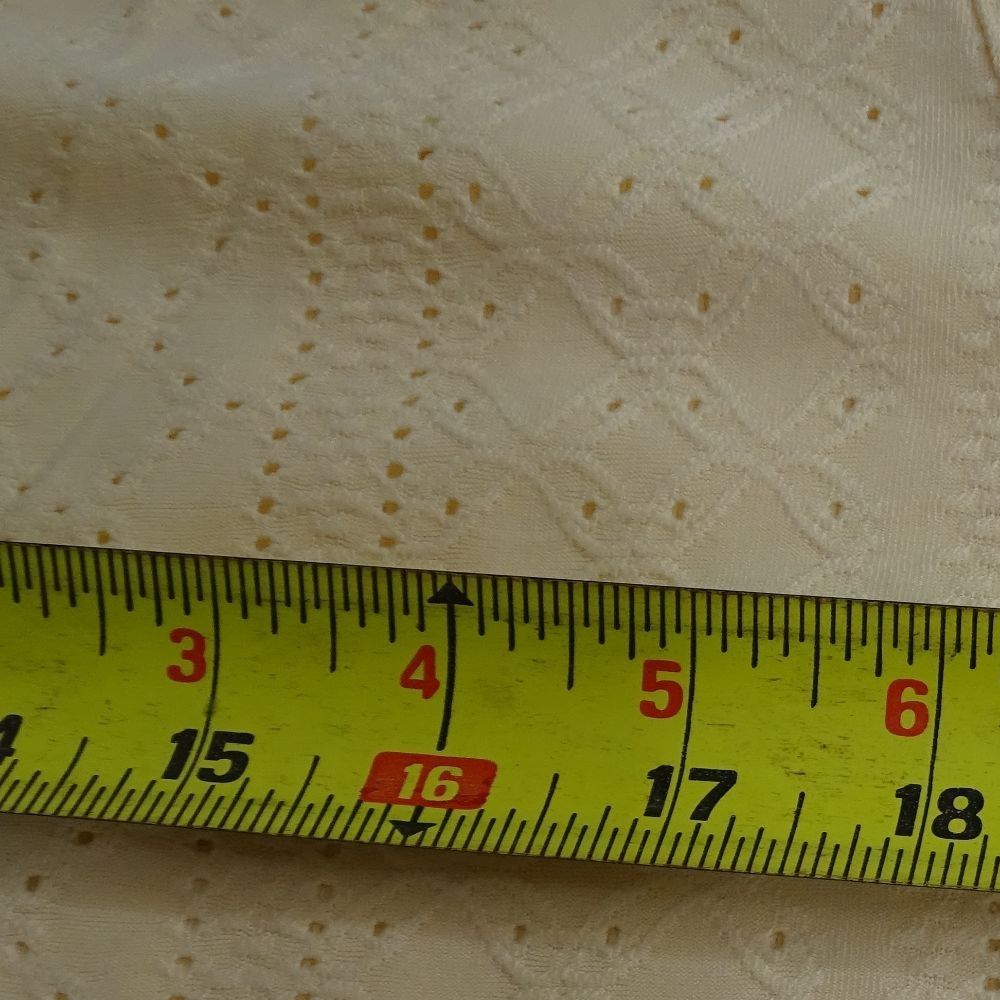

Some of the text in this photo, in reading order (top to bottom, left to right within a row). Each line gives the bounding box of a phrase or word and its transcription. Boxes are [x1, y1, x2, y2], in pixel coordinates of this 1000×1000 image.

[166, 627, 207, 683] 3
[400, 645, 441, 699] 4
[639, 659, 685, 719] 5
[884, 679, 930, 737] 6
[161, 728, 256, 784] 15
[398, 762, 464, 802] 16
[643, 764, 738, 822] 17
[894, 783, 985, 841] 18
